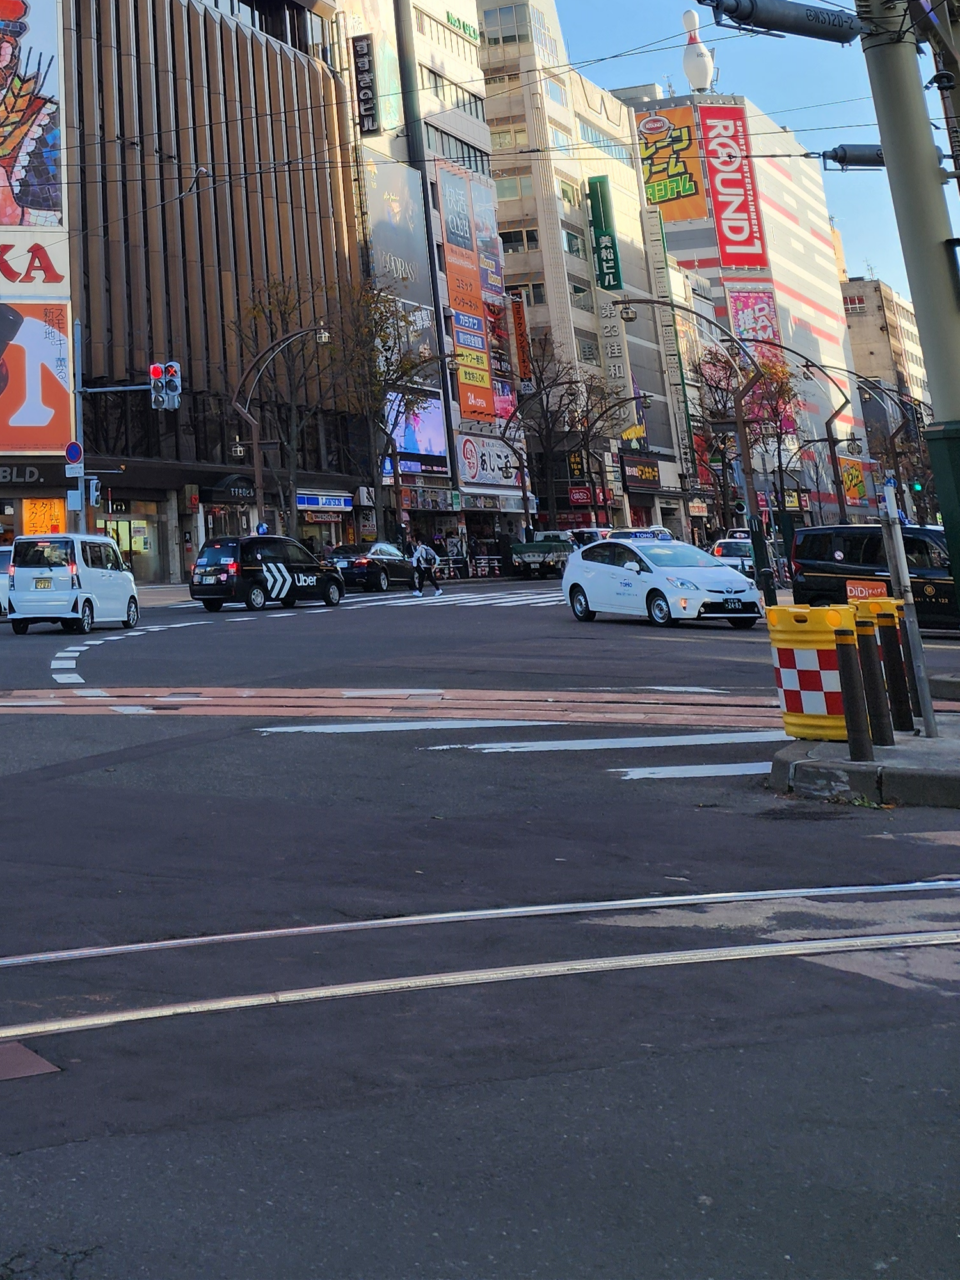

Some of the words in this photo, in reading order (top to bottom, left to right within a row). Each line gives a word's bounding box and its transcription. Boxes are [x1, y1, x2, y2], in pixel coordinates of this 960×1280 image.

[355, 39, 378, 131] すすきのビル
[640, 127, 690, 158] レーン
[706, 120, 762, 253] ROUND1
[736, 121, 746, 157] SPORTS
[742, 160, 760, 240] ENTERTAINMENT
[599, 235, 618, 287] 美松ビル
[456, 278, 473, 293] コミック
[454, 297, 479, 311] インターネット
[459, 316, 478, 328] カラオケ
[321, 497, 343, 507] LAWSON
[295, 573, 317, 586] Uber
[847, 586, 868, 597] DiDi
